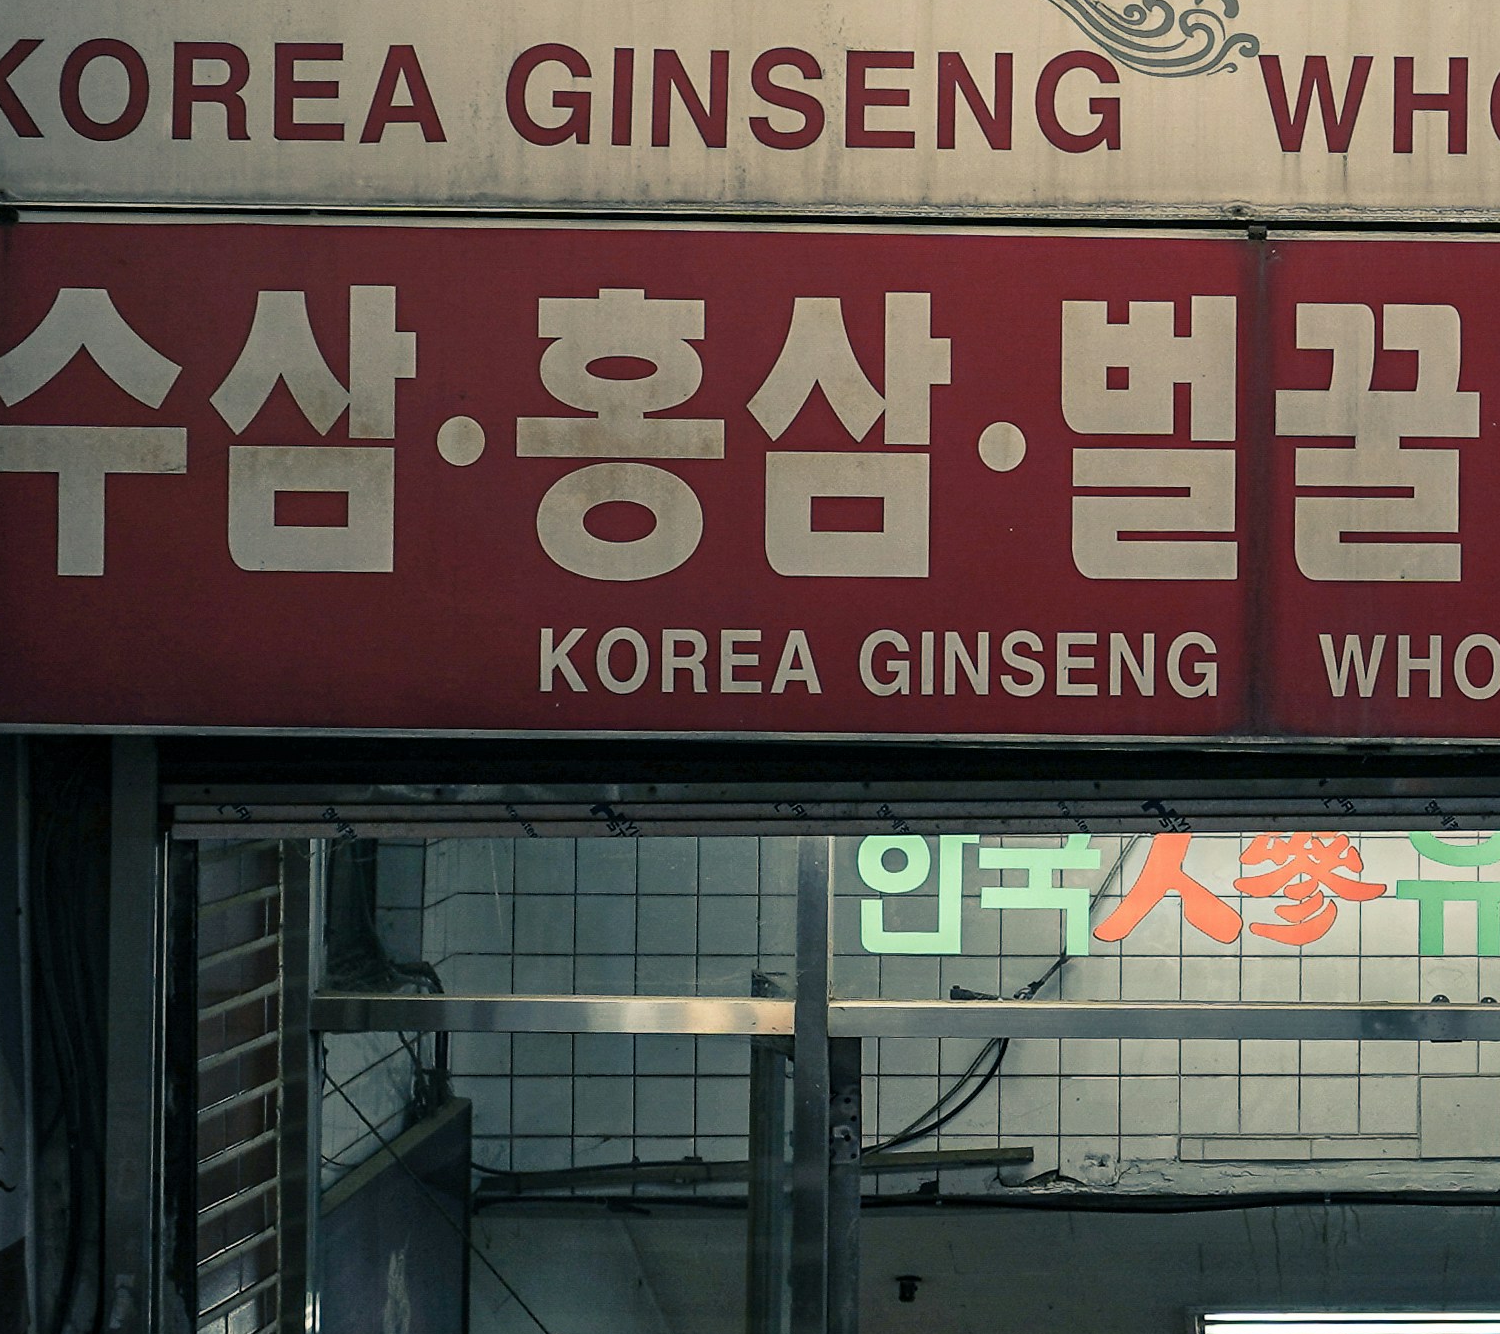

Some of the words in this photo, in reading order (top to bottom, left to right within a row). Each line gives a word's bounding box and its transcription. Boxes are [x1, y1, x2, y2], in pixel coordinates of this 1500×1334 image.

[506, 43, 1124, 154] GINSENG
[540, 626, 822, 695] KOREA
[857, 629, 1221, 698] GINSENG
